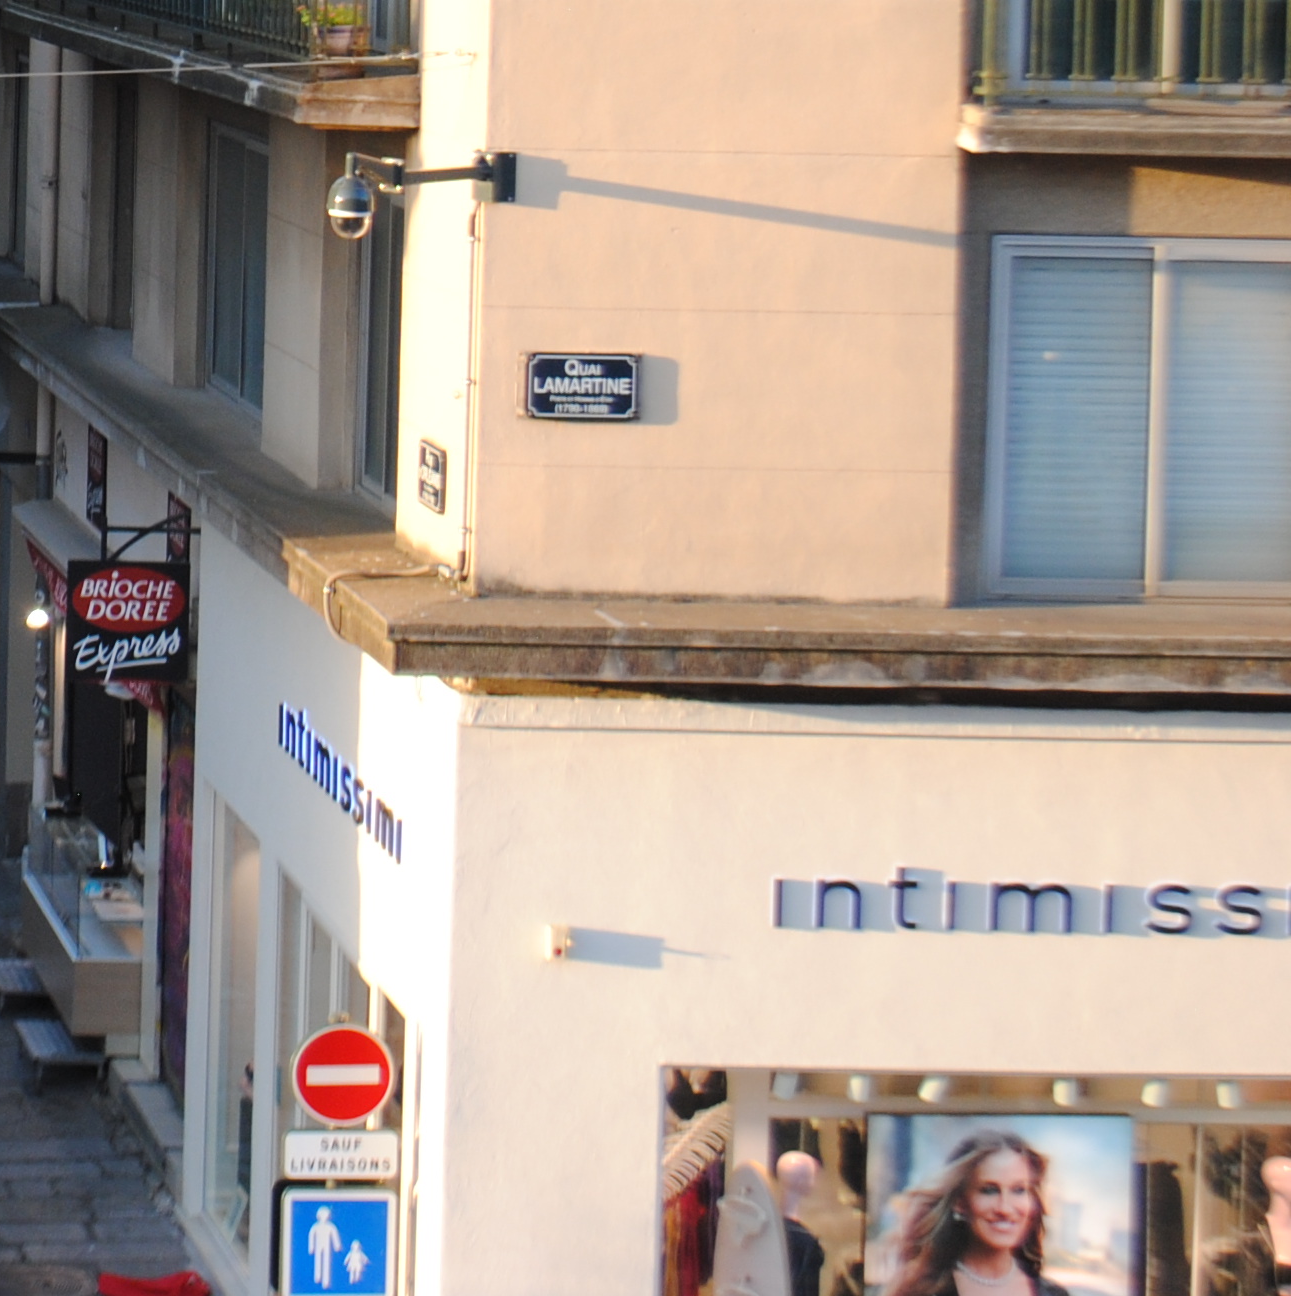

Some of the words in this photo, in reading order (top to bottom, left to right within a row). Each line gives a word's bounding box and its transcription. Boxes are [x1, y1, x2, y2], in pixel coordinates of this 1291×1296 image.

[534, 376, 632, 395] LAMARTINE
[73, 627, 181, 684] Express
[320, 1136, 363, 1152] SAUF
[290, 1157, 391, 1173] LIVRAISONS
